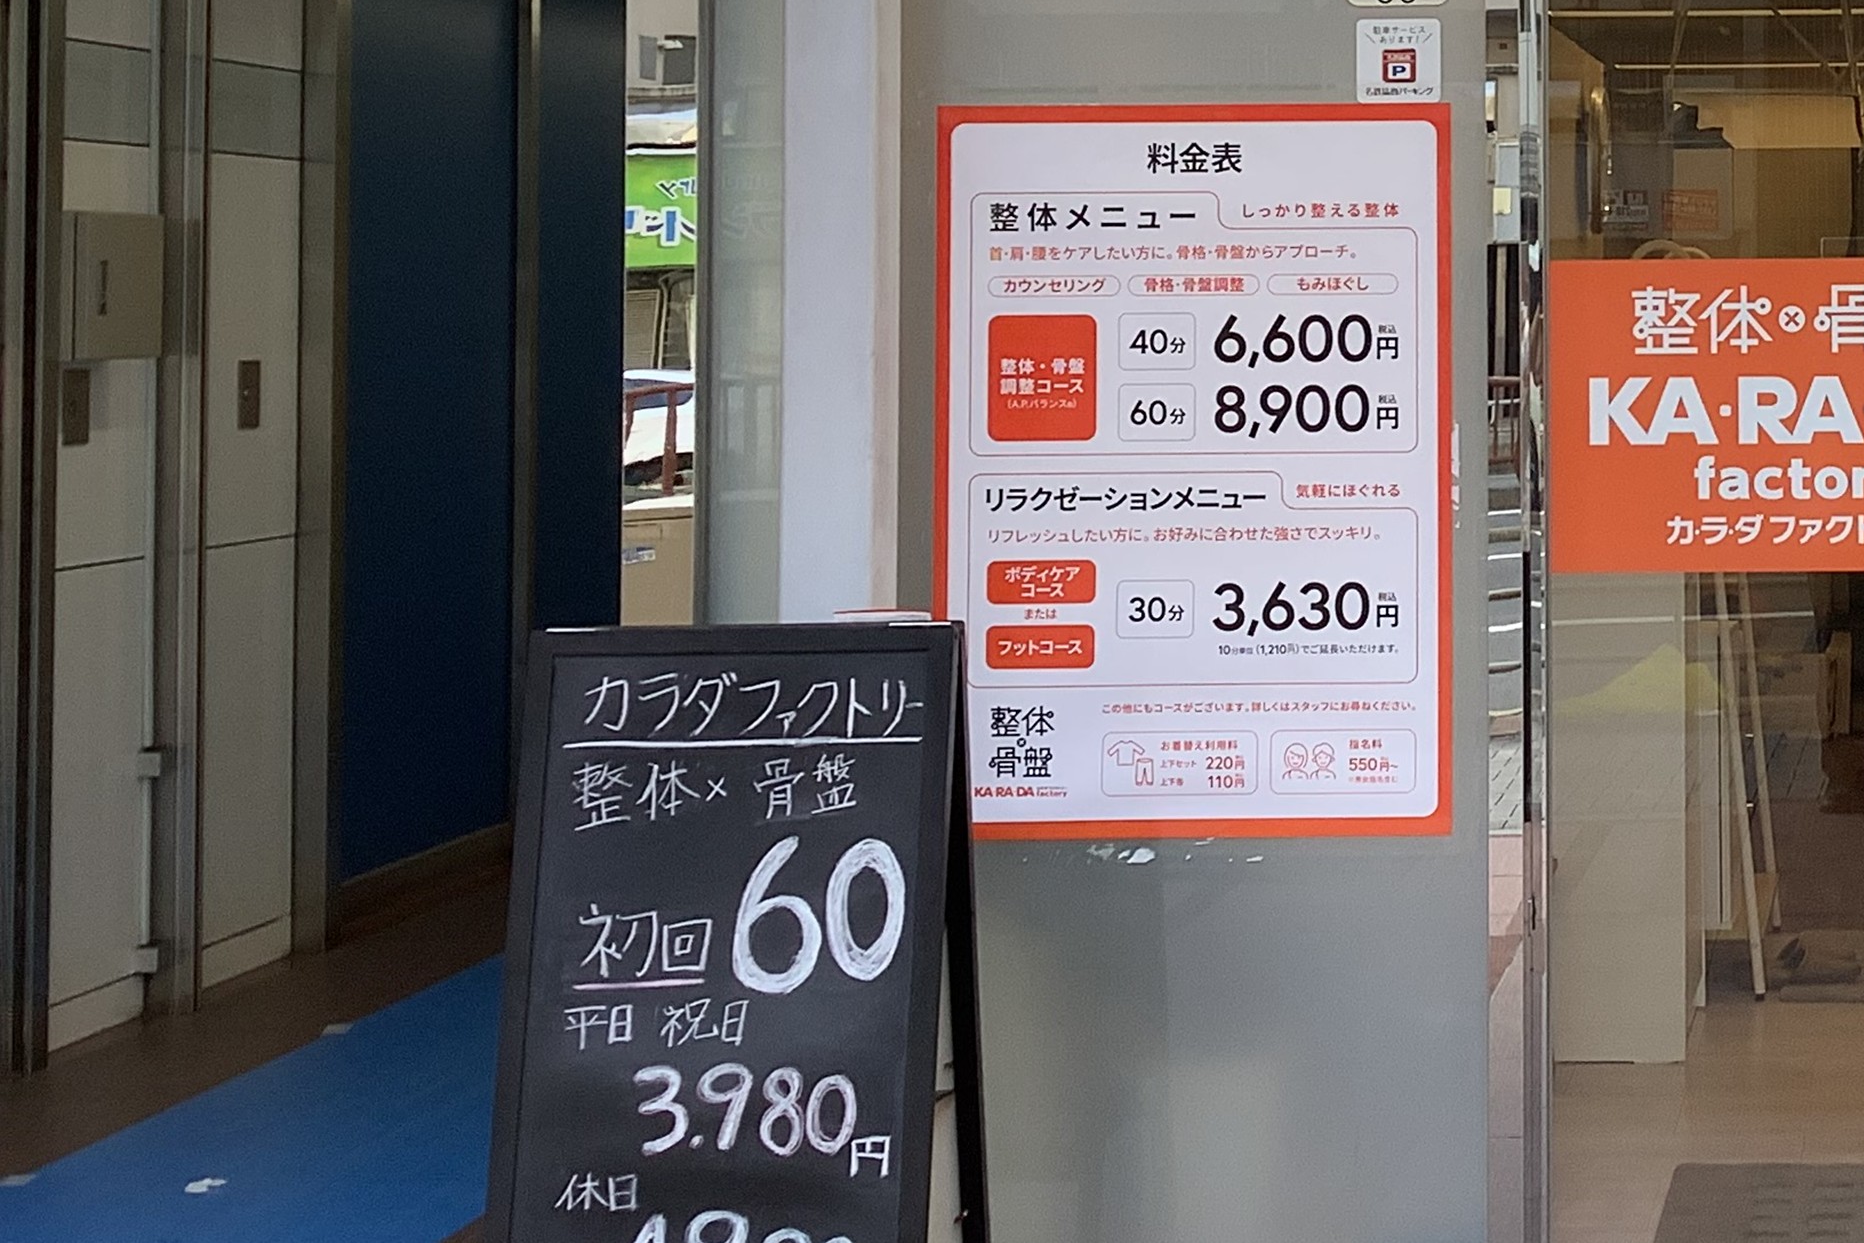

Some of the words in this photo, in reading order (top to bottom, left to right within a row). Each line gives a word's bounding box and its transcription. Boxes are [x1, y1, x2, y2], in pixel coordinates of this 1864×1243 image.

[1392, 65, 1407, 77] P
[1147, 142, 1242, 174] 料金表
[989, 202, 1196, 233] 整体メニュー
[1242, 202, 1399, 218] しっかり整える整体
[1003, 277, 1106, 293] カウンセリング
[1296, 276, 1369, 292] もみほぐし
[1129, 328, 1186, 354] 40分
[1000, 358, 1085, 376] 整体・骨盤
[1000, 378, 1084, 395] 調整コース
[1129, 399, 1186, 426] 60分
[985, 485, 1268, 513] リラクゼーションメニュー
[1296, 482, 1401, 499] 気軽にほぐれる
[1005, 566, 1080, 583] ボディケア
[1021, 583, 1065, 598] コース
[1024, 608, 1057, 620] または
[1128, 596, 1185, 623] 30分
[998, 639, 1083, 657] フットコース
[583, 670, 925, 740] カラダファクトリー
[990, 705, 1055, 737] 整体
[988, 746, 1053, 778] 骨盤
[1206, 756, 1245, 770] 220円
[1208, 775, 1245, 789] 110円
[576, 900, 714, 979] 初回
[731, 834, 907, 995] 60
[563, 1004, 633, 1050] 平日
[660, 998, 750, 1048] 祝日
[554, 1172, 639, 1213] 休日
